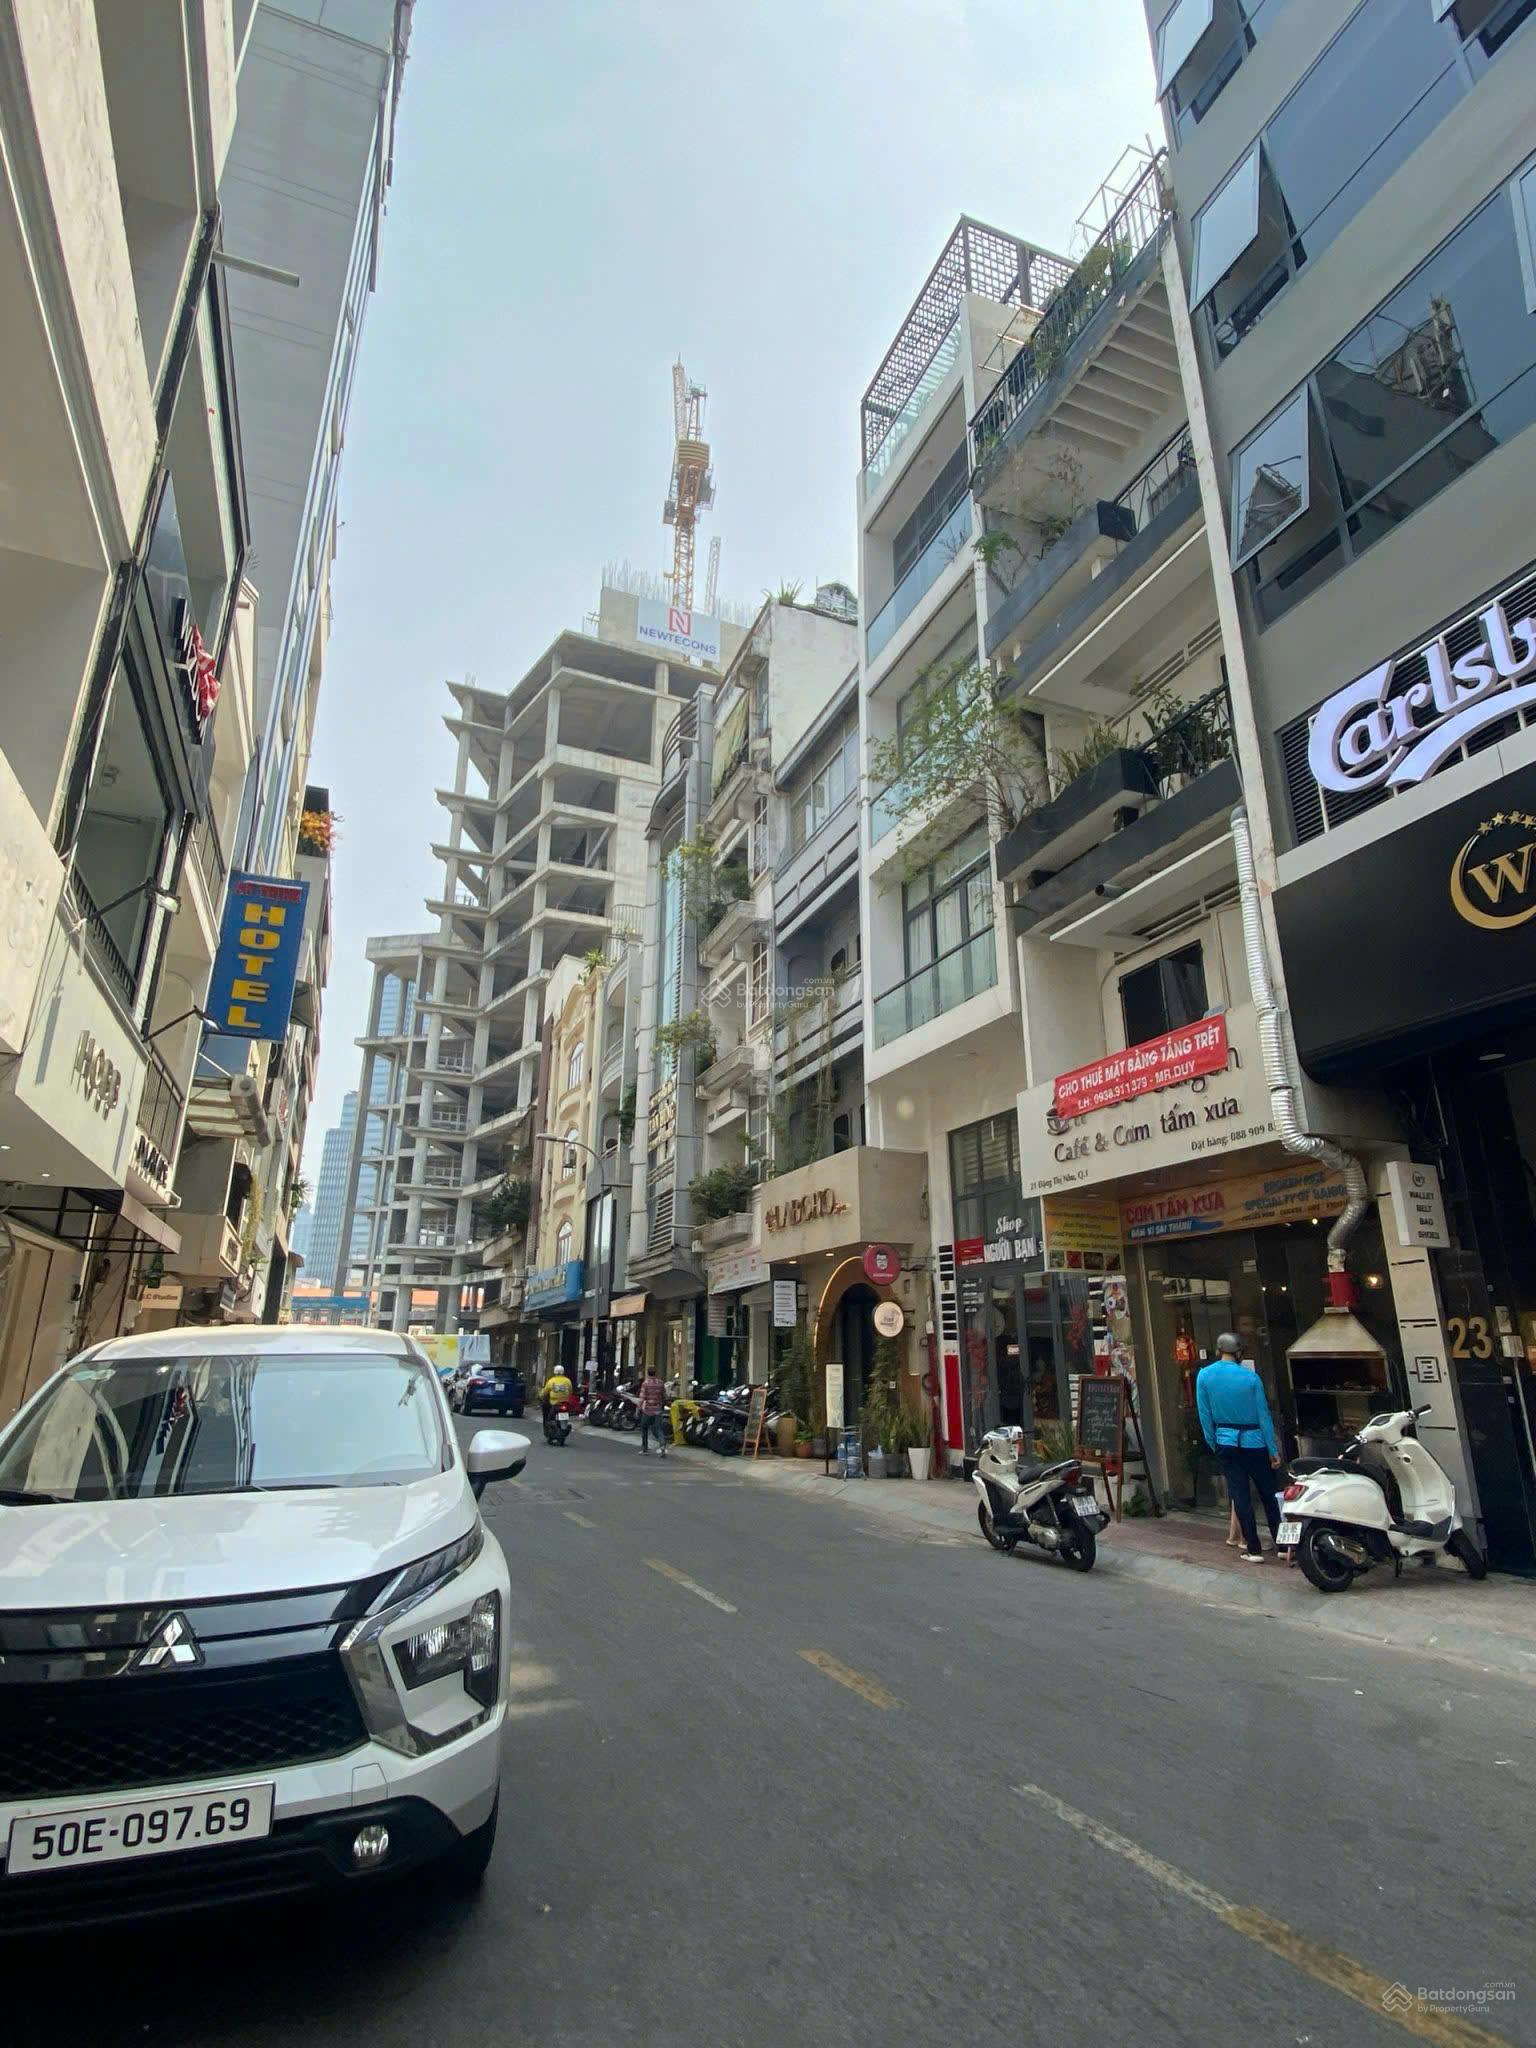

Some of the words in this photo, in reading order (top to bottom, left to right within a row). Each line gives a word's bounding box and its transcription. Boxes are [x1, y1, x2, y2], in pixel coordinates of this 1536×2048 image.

[639, 625, 716, 655] NEWTECONS
[228, 903, 286, 1028] HOTEL
[1059, 1080, 1079, 1099] CHO
[1081, 1067, 1104, 1090] THUÊ
[1105, 1060, 1125, 1082] MẶT
[1194, 1025, 1220, 1050] TRỆT
[1155, 1060, 1195, 1084] MR.DUY
[1054, 1136, 1089, 1163] Café
[1095, 1132, 1108, 1152] &
[1160, 1103, 1196, 1134] tấm
[1204, 1097, 1239, 1123] xưa
[1231, 1128, 1247, 1142] 088
[1248, 1124, 1265, 1137] 909
[1409, 1191, 1434, 1200] WALLET
[1416, 1204, 1432, 1213] BELT
[996, 1216, 1022, 1235] Shop
[1447, 1316, 1492, 1359] 23
[32, 1797, 251, 1861] 50E-097.69
